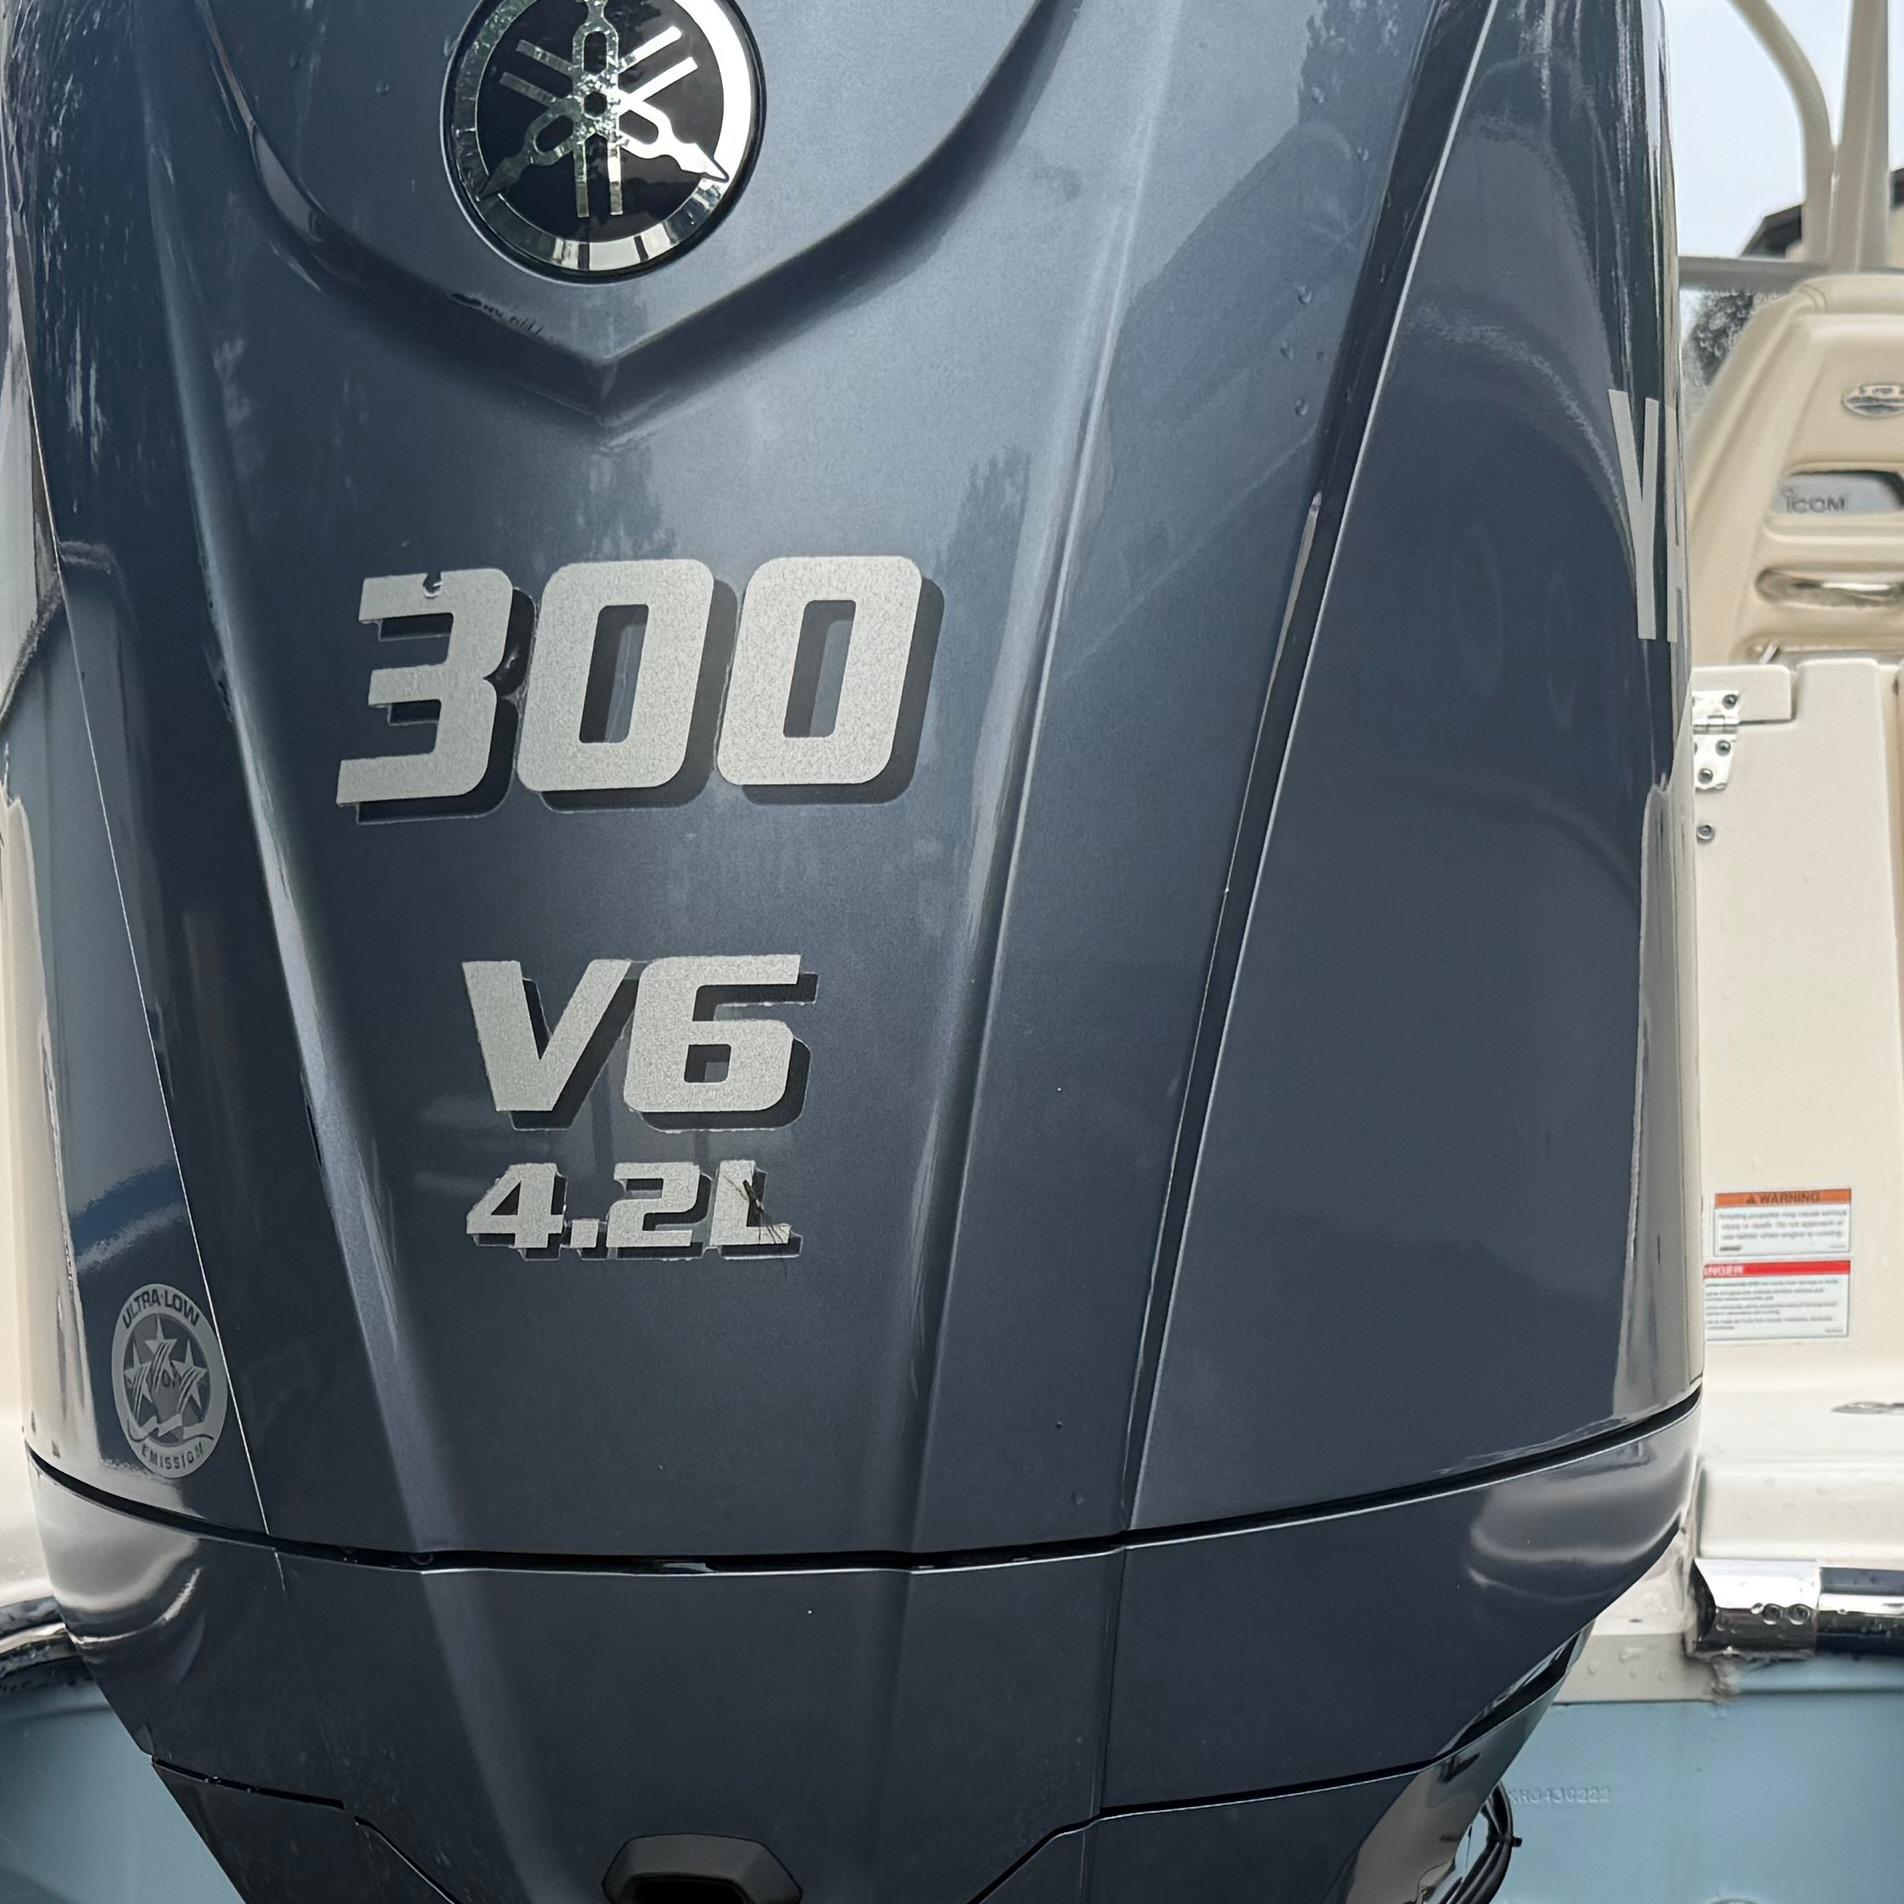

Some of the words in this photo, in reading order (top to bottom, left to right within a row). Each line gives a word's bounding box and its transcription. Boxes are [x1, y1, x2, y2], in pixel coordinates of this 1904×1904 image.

[337, 556, 936, 815] 300
[462, 955, 809, 1122] V6
[466, 1160, 798, 1256] 4.2L
[1760, 1192, 1821, 1204] WARNING
[141, 1442, 205, 1471] EMISSION
